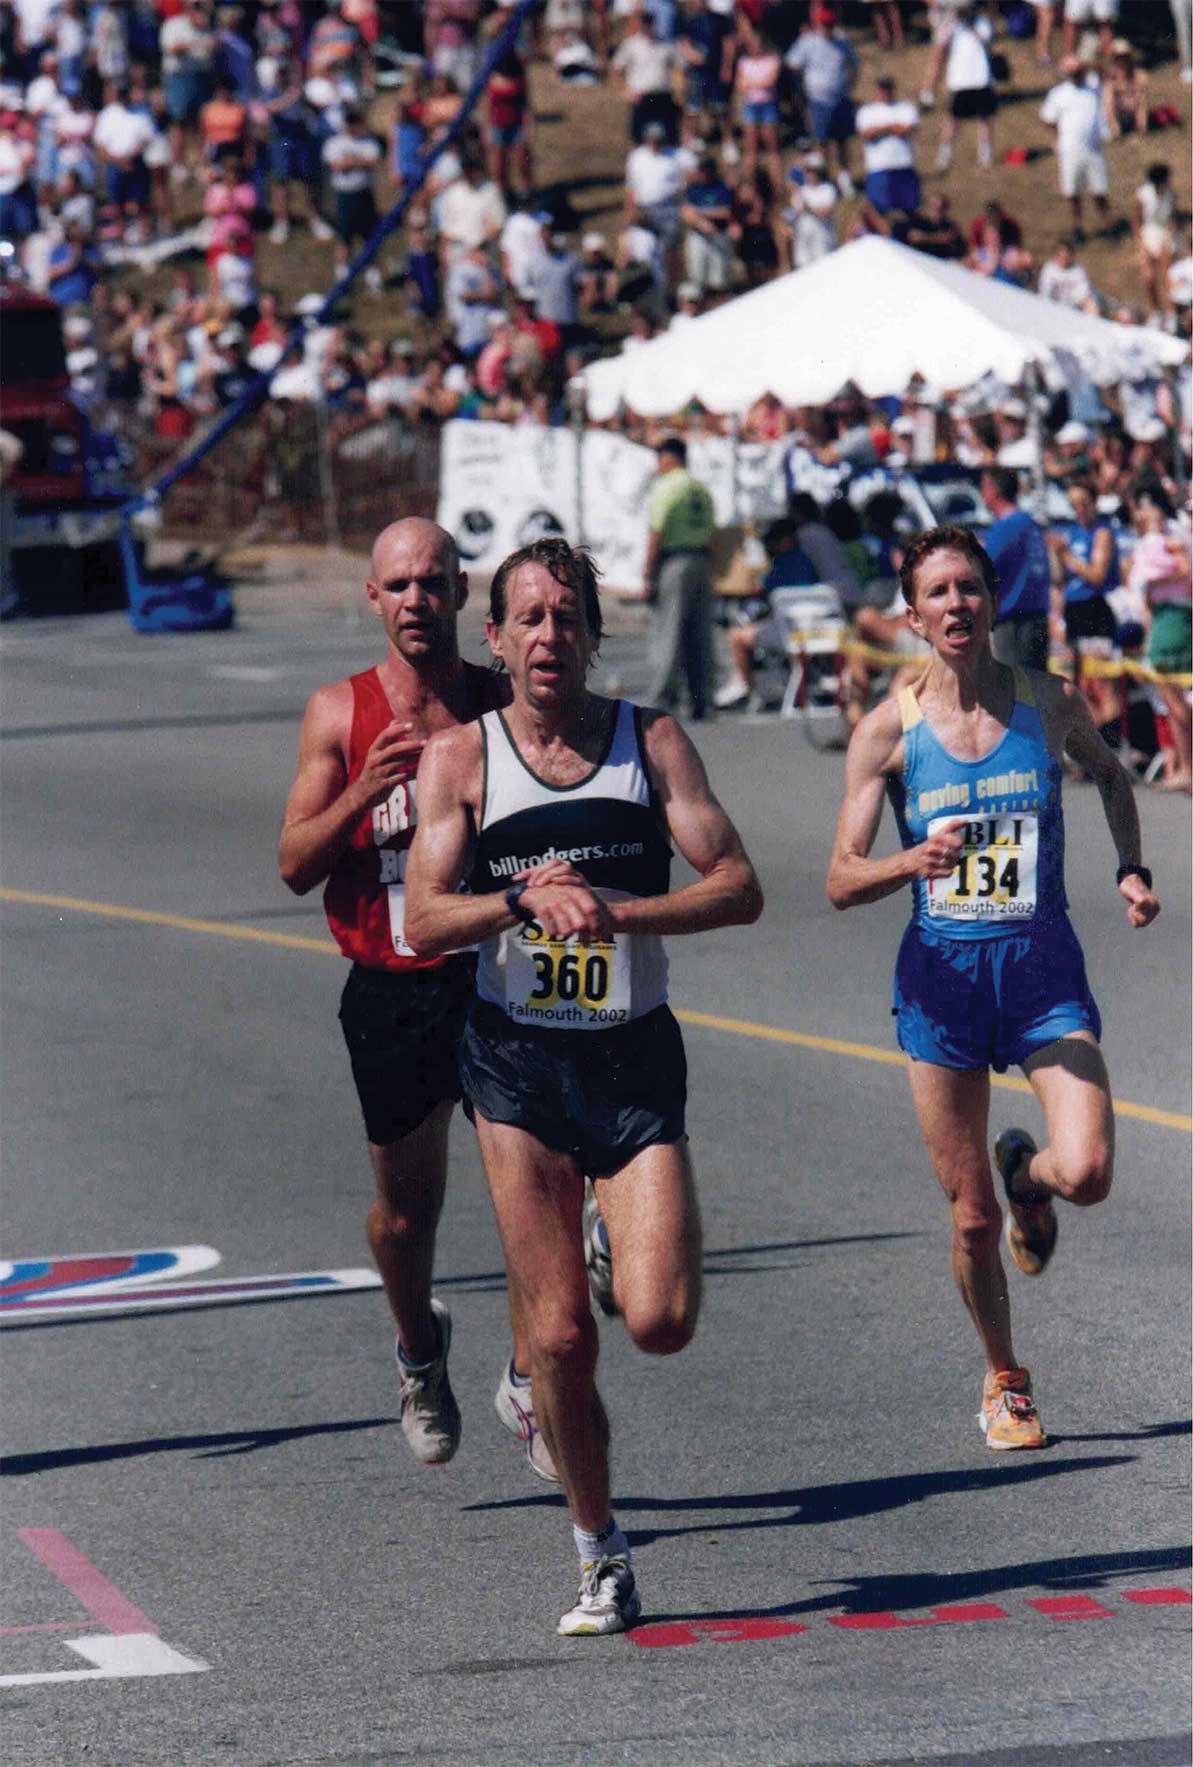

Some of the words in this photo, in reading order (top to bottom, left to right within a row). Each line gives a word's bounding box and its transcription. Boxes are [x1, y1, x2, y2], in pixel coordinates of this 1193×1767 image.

[976, 768, 1039, 799] comfort
[963, 819, 1024, 846] BLI
[488, 842, 644, 877] billrodgers.com
[955, 855, 1020, 898] 134
[930, 899, 994, 914] Falmouth
[999, 901, 1033, 914] 2002
[395, 935, 410, 948] Fa
[531, 952, 608, 1002] 360
[508, 1001, 583, 1021] Falmouth
[588, 1008, 627, 1022] 2002
